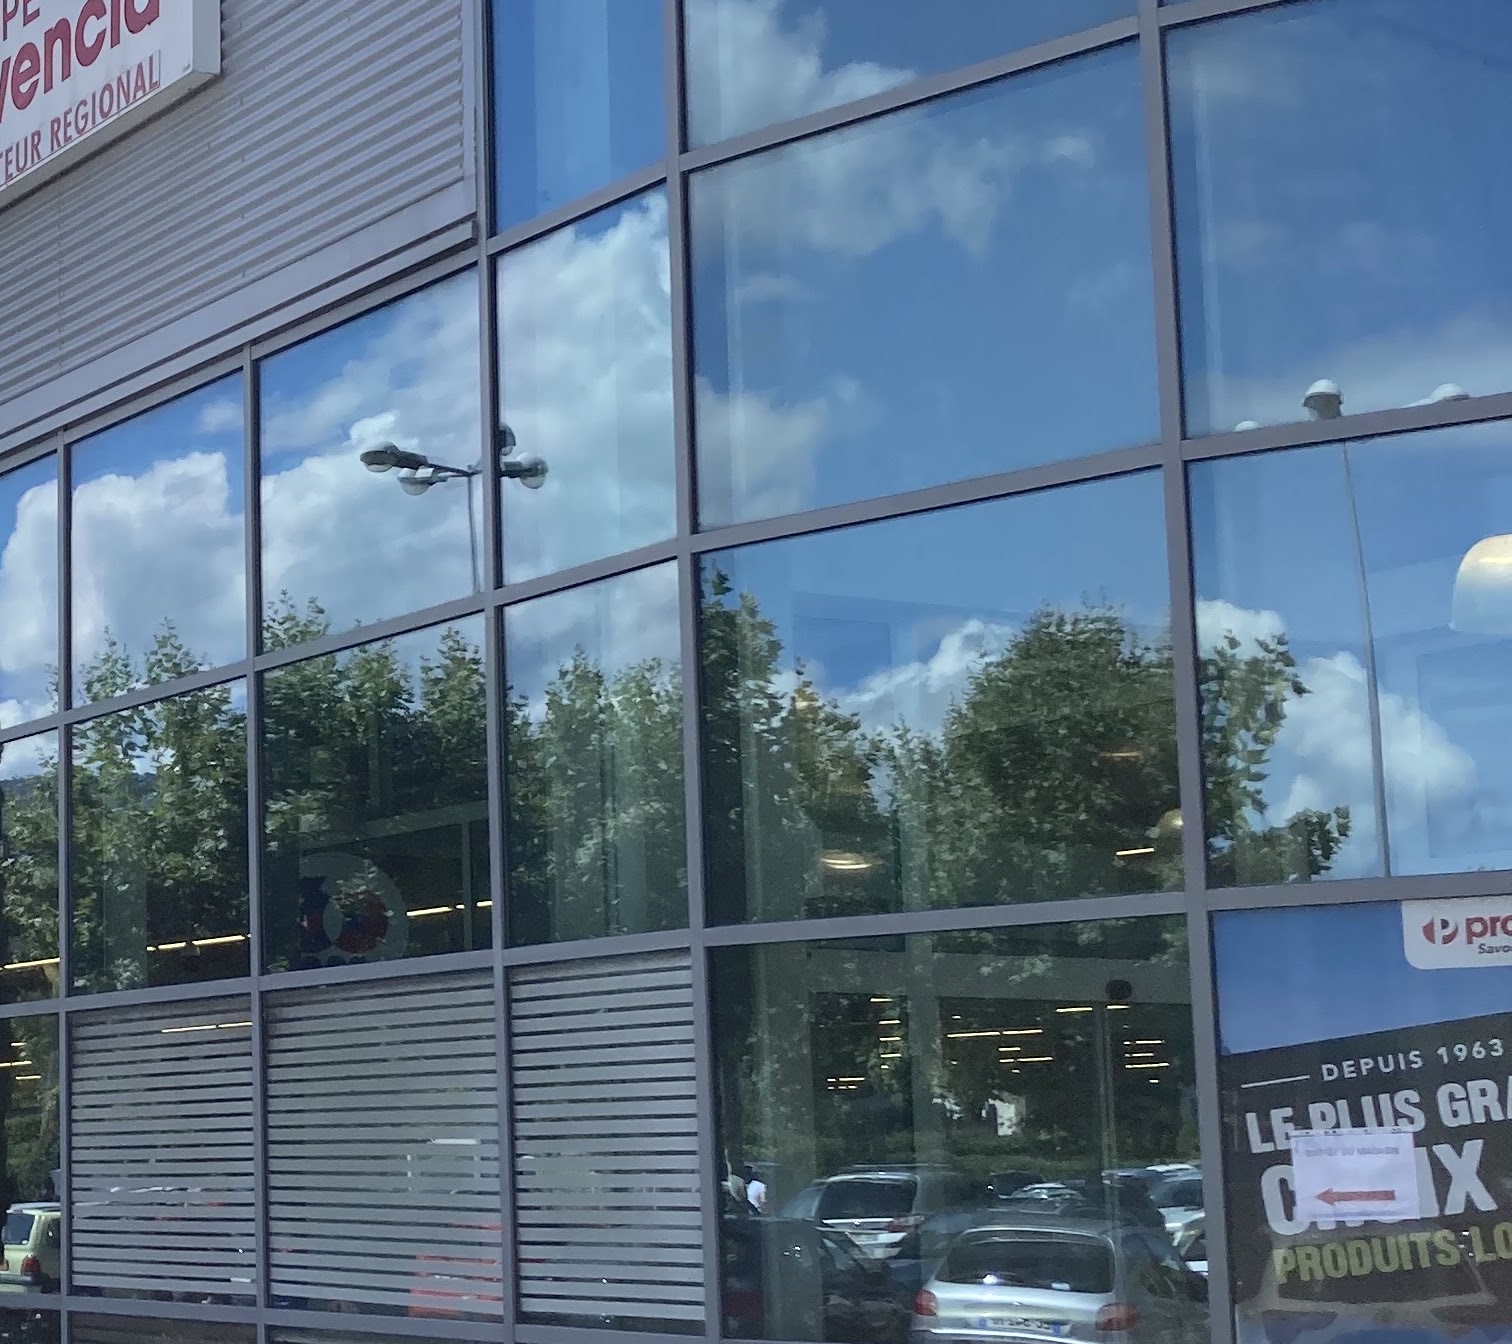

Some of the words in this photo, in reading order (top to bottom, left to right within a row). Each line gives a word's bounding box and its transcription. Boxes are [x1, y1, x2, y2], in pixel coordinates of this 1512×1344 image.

[50, 54, 159, 154] REGIONAL
[1321, 1049, 1424, 1082] DEPUIS
[1436, 1037, 1505, 1065] 1963
[1245, 1105, 1296, 1155] LE
[1436, 1073, 1512, 1129] GR
[1260, 1138, 1499, 1237] CIX
[1272, 1227, 1462, 1286] PRODUITS
